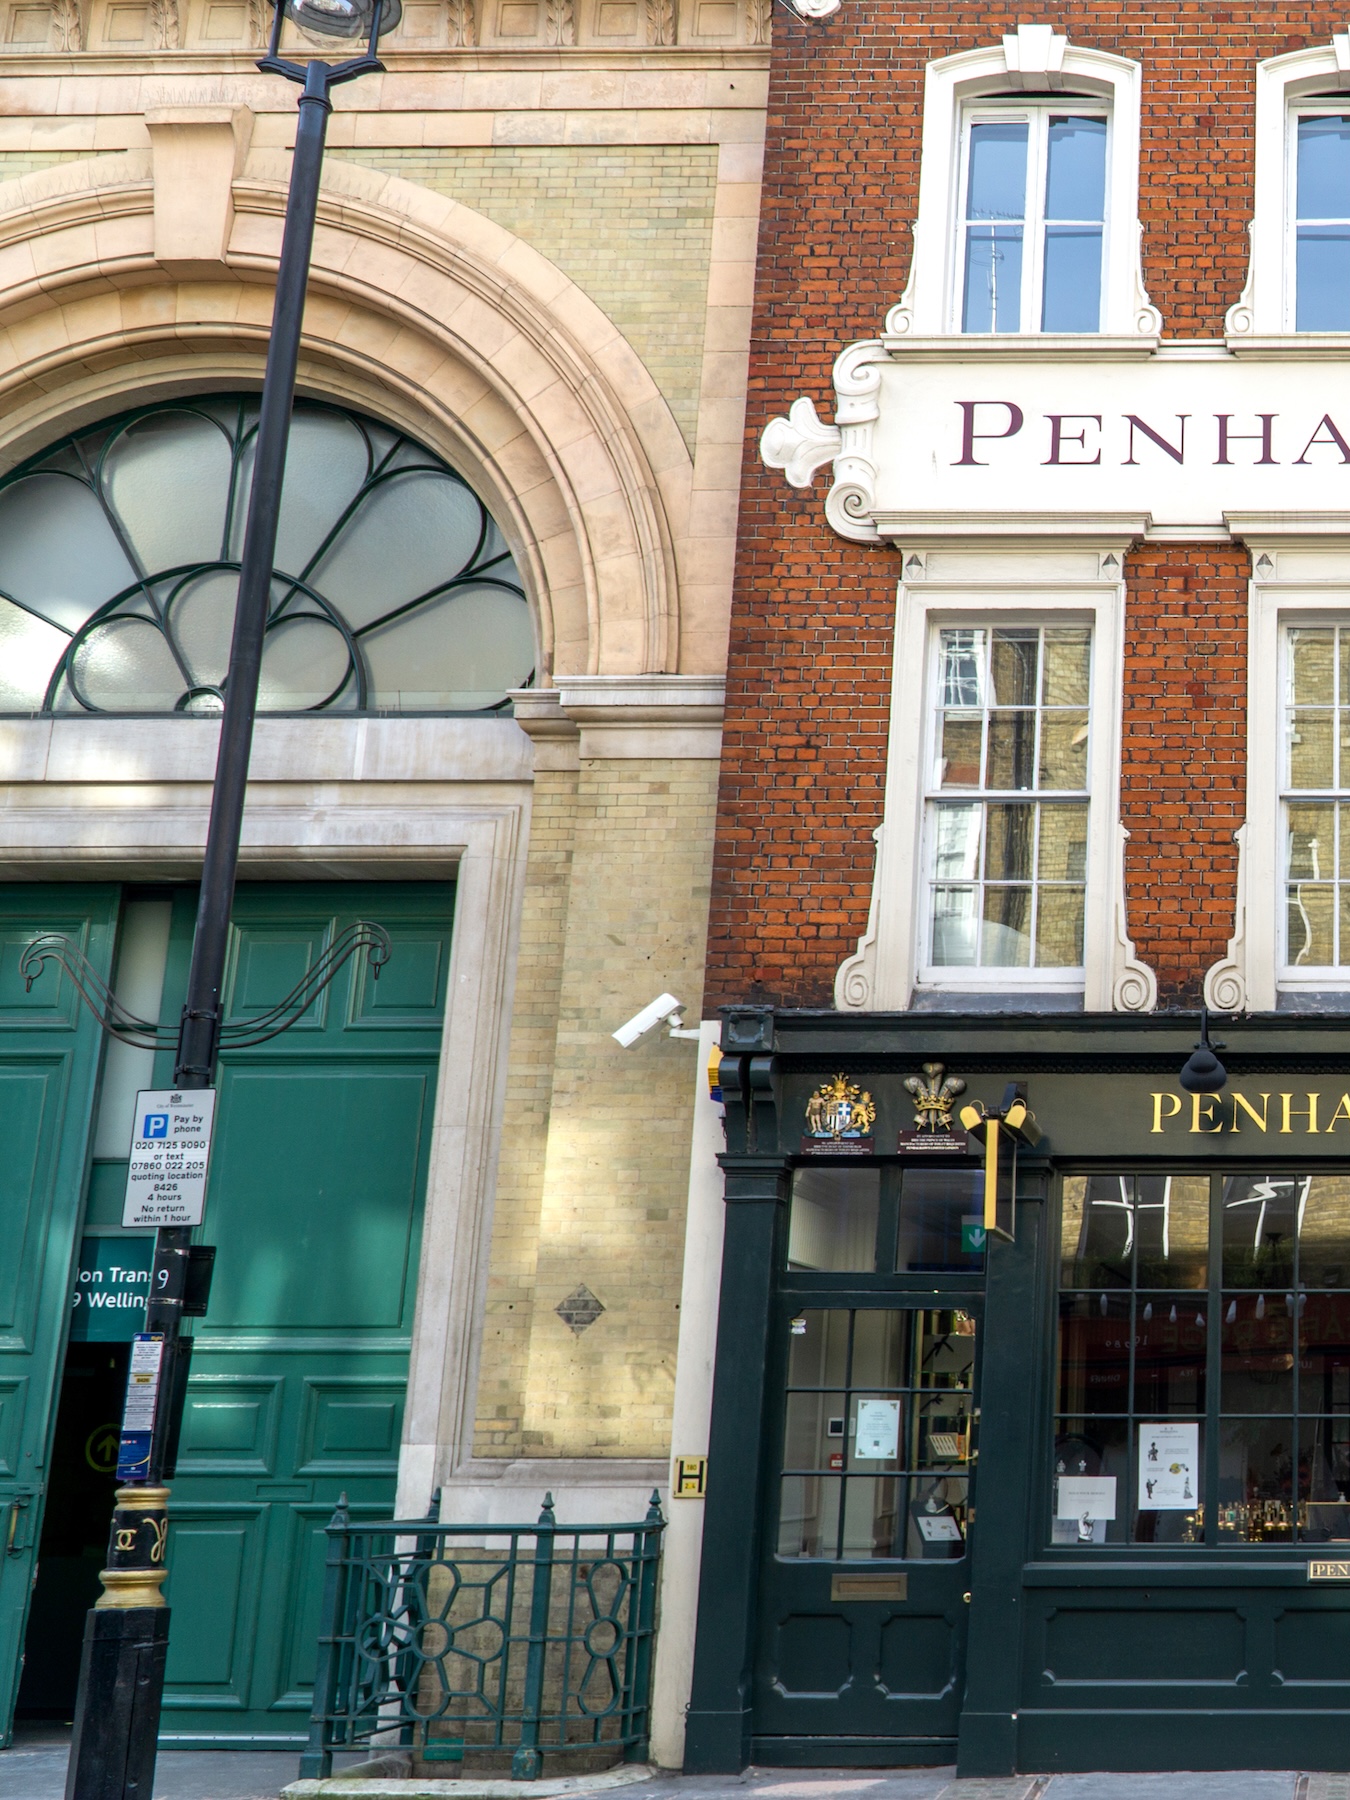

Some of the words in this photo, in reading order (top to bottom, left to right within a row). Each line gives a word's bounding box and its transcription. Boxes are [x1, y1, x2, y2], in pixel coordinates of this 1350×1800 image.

[173, 1115, 190, 1124] Pay
[192, 1115, 204, 1124] by
[173, 1125, 201, 1134] phone
[135, 1141, 154, 1150] 020
[157, 1141, 178, 1149] 7125
[180, 1140, 206, 1149] 9090
[153, 1153, 163, 1161] or
[166, 1152, 184, 1160] text
[131, 1162, 162, 1170] 07860
[164, 1161, 183, 1170] 022
[185, 1161, 205, 1169] 205
[131, 1172, 165, 1181] quoting
[167, 1171, 203, 1180] location
[153, 1183, 178, 1191] 8426
[147, 1193, 154, 1201] 4
[156, 1193, 182, 1201] hours
[141, 1205, 154, 1213] No
[133, 1215, 161, 1223] within
[164, 1214, 168, 1222] 1
[170, 1214, 191, 1222] hour
